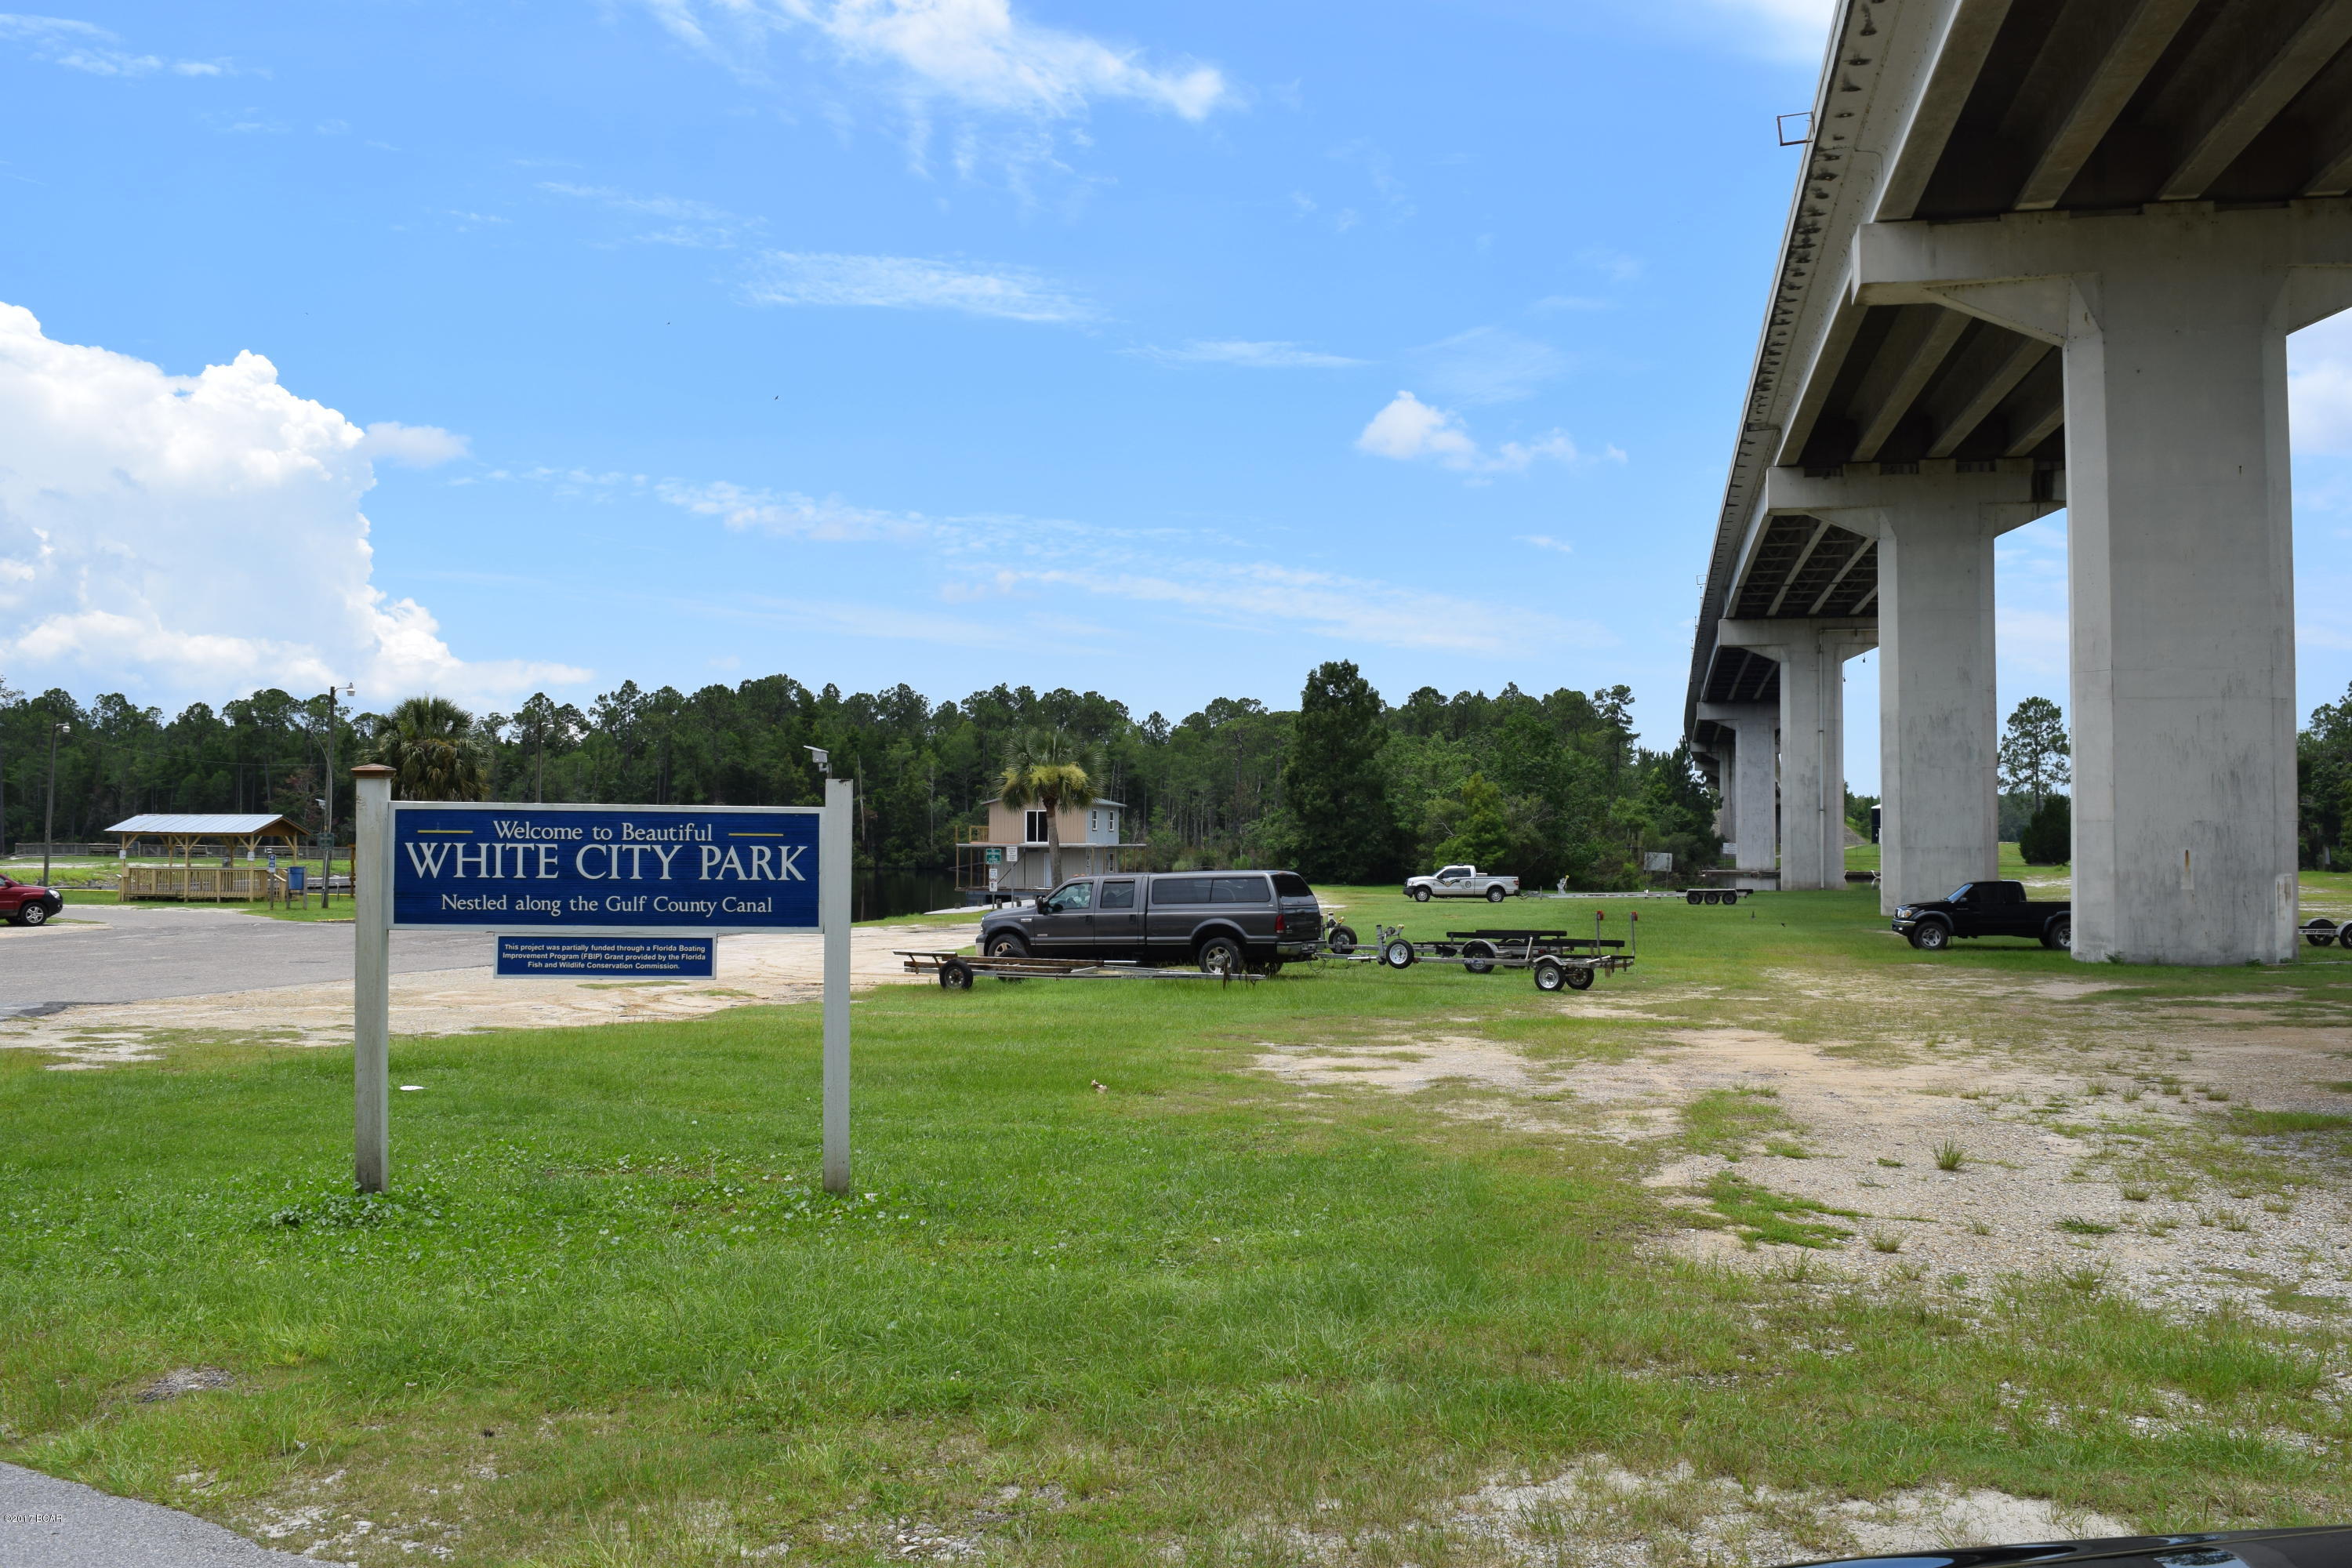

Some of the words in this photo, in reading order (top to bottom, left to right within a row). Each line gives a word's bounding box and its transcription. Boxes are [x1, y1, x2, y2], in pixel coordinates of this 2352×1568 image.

[493, 820, 583, 840] Welcome
[592, 826, 613, 840] to
[622, 822, 713, 841] Beautiful
[405, 842, 559, 880] WHITE
[575, 844, 683, 880] CITY
[699, 845, 808, 881] PARK
[441, 894, 507, 911] Nestled
[515, 895, 561, 917] along
[569, 895, 598, 911] the
[605, 895, 648, 912] Gulf
[653, 896, 717, 918] County
[722, 897, 772, 913] Canal
[549, 953, 579, 961] Program
[658, 953, 667, 962] by
[561, 944, 589, 953] partially
[616, 945, 644, 953] through
[679, 945, 706, 954] Boating
